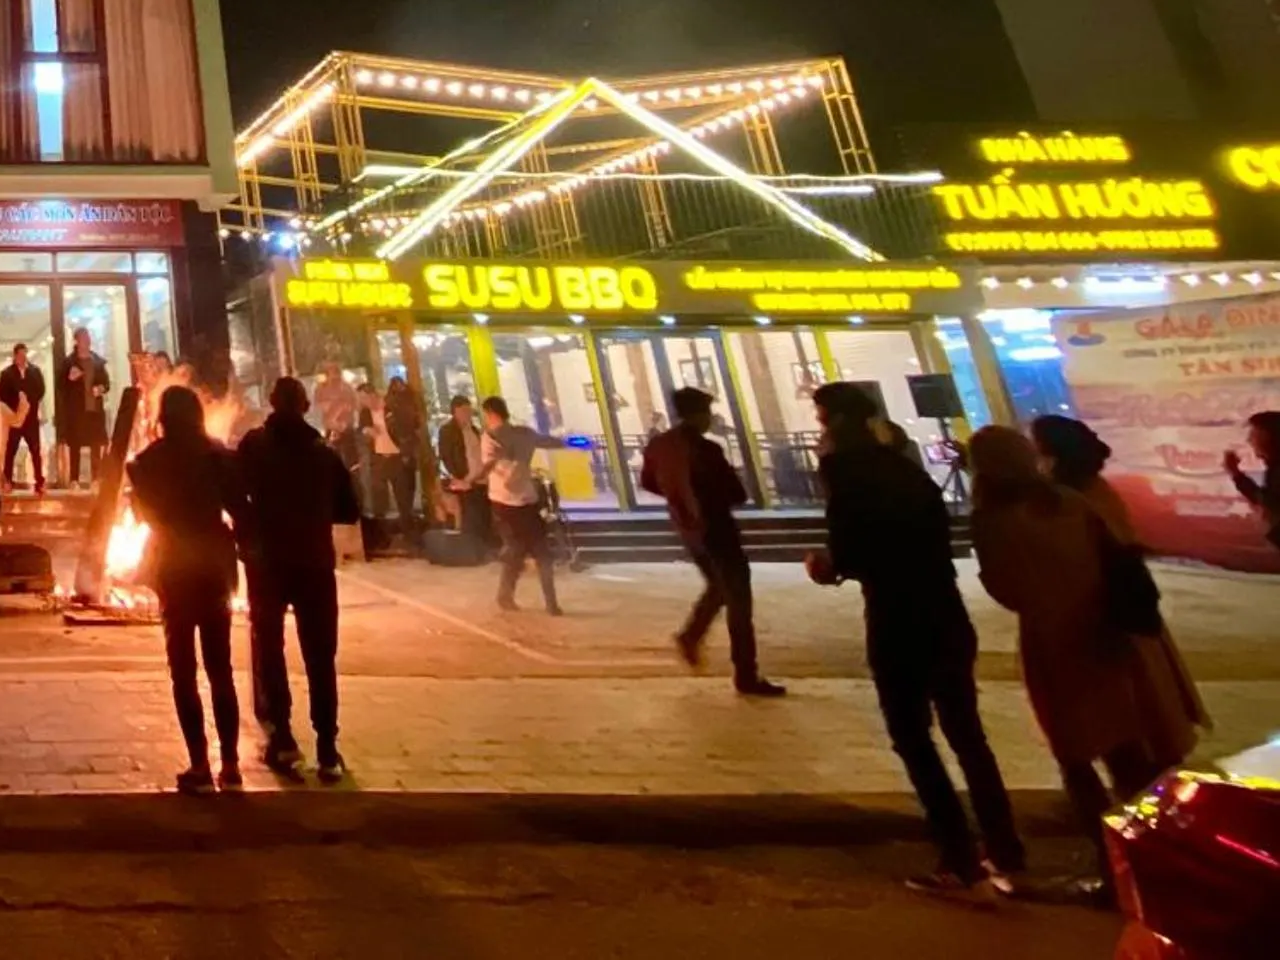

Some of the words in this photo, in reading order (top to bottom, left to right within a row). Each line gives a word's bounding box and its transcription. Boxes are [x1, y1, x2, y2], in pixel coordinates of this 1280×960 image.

[932, 167, 1060, 219] TUẤN
[423, 263, 552, 310] SUSU
[553, 265, 659, 311] BBQ
